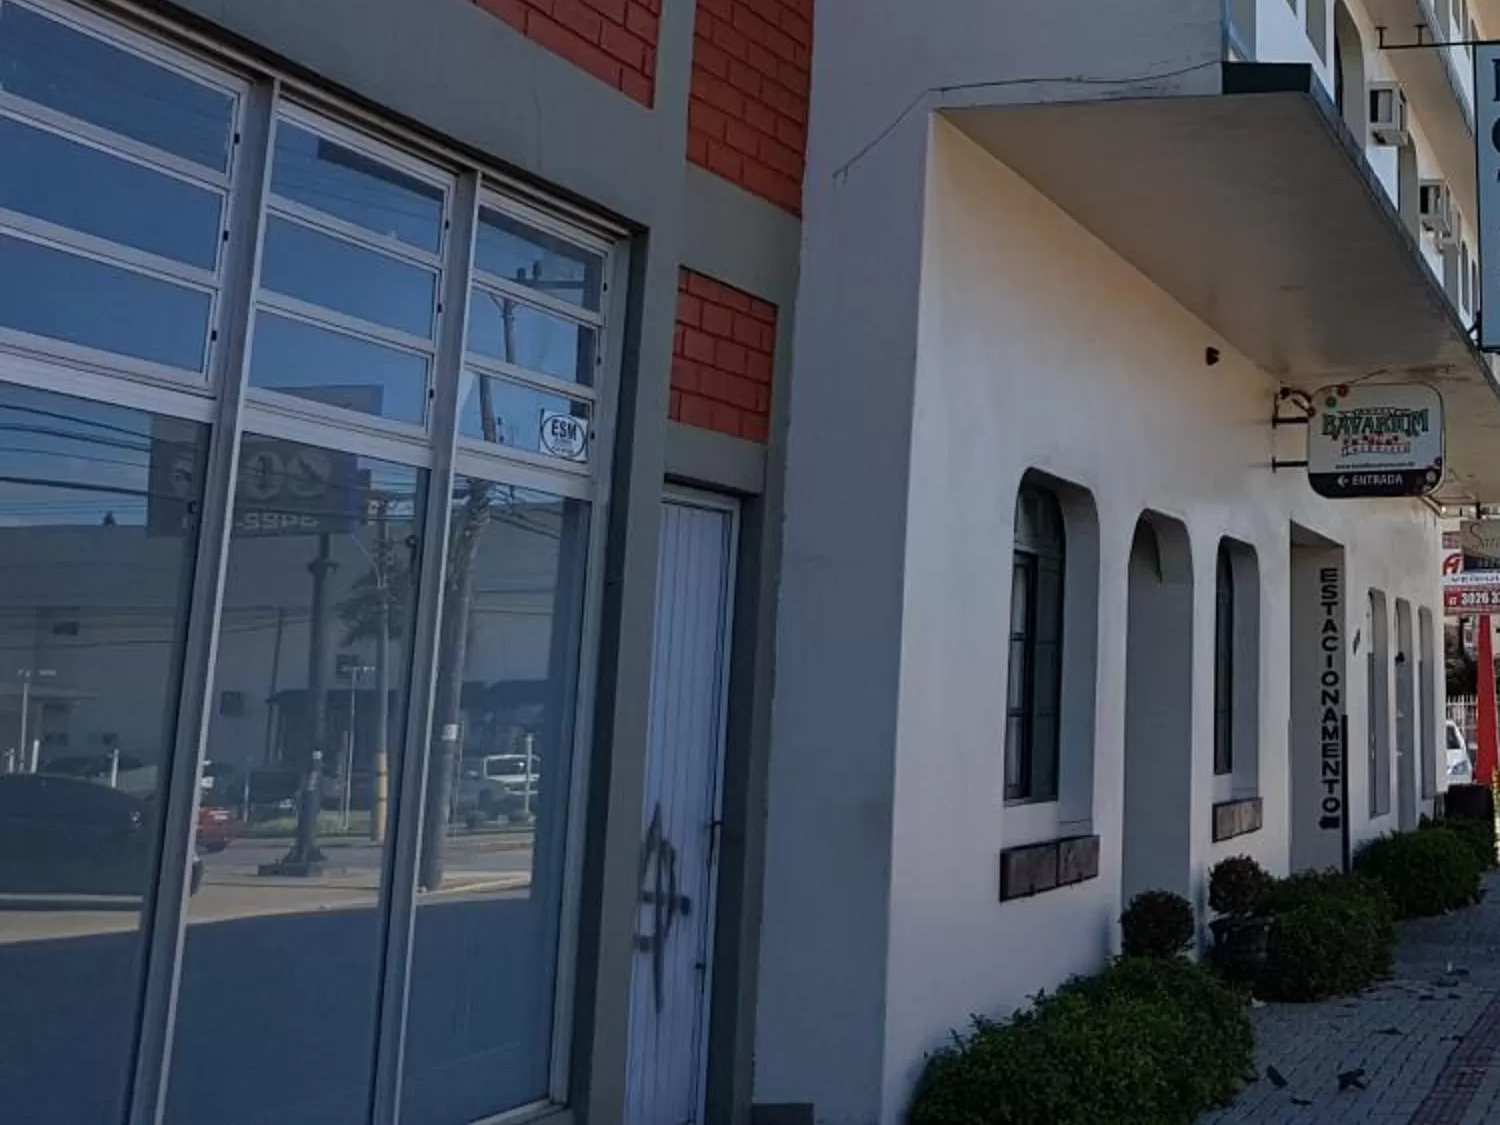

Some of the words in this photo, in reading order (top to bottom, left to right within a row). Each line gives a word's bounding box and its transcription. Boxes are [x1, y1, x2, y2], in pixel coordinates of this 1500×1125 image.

[551, 418, 577, 441] ESM
[1351, 474, 1404, 486] ENTRADA
[1320, 568, 1340, 813] ESTACIONAMENTO
